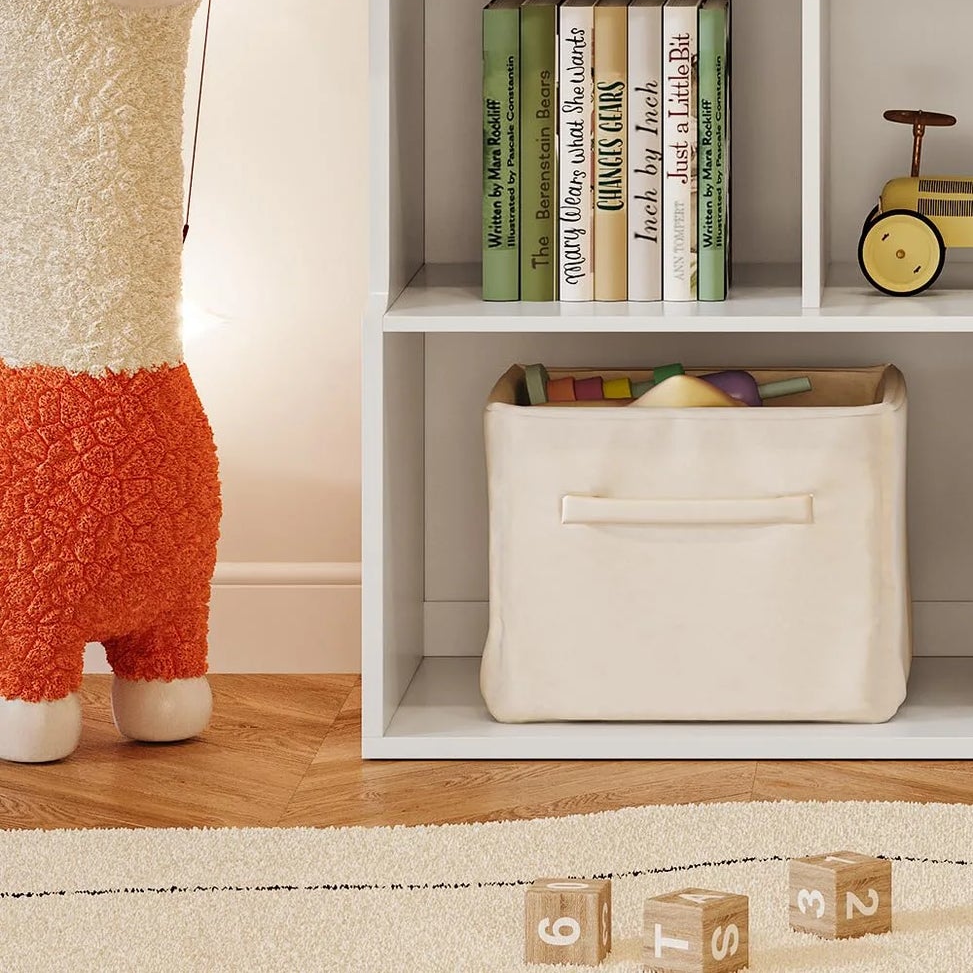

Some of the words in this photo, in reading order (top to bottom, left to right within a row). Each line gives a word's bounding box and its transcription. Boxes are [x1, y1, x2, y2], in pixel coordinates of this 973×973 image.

[669, 32, 690, 63] Bit
[506, 55, 515, 122] Constantin
[536, 69, 551, 119] Bears
[562, 86, 585, 114] She
[597, 81, 626, 133] GEARS
[634, 80, 659, 136] Inch
[668, 64, 690, 118] Little
[486, 98, 501, 146] Rockliff
[676, 121, 689, 134] a
[702, 98, 713, 146] Rockliff
[488, 148, 502, 181] Mara
[507, 125, 515, 167] Pascale
[634, 148, 662, 176] by
[667, 140, 689, 185] Just
[703, 149, 713, 180] Mara
[488, 183, 504, 199] by
[508, 170, 517, 185] by
[536, 129, 550, 220] Berenstain
[560, 169, 587, 223] Wears
[597, 138, 625, 211] CHANGES
[703, 183, 714, 197] by
[488, 200, 503, 248] Written
[507, 188, 516, 247] Illustrated
[634, 188, 658, 244] Inch
[673, 200, 685, 254] TOMPERT
[702, 201, 713, 248] Written
[531, 235, 549, 269] The
[563, 227, 586, 285] Mary
[673, 256, 685, 281] ANN
[797, 888, 826, 919] 3
[846, 888, 879, 920] 2
[654, 923, 689, 958] T
[711, 923, 739, 961] S
